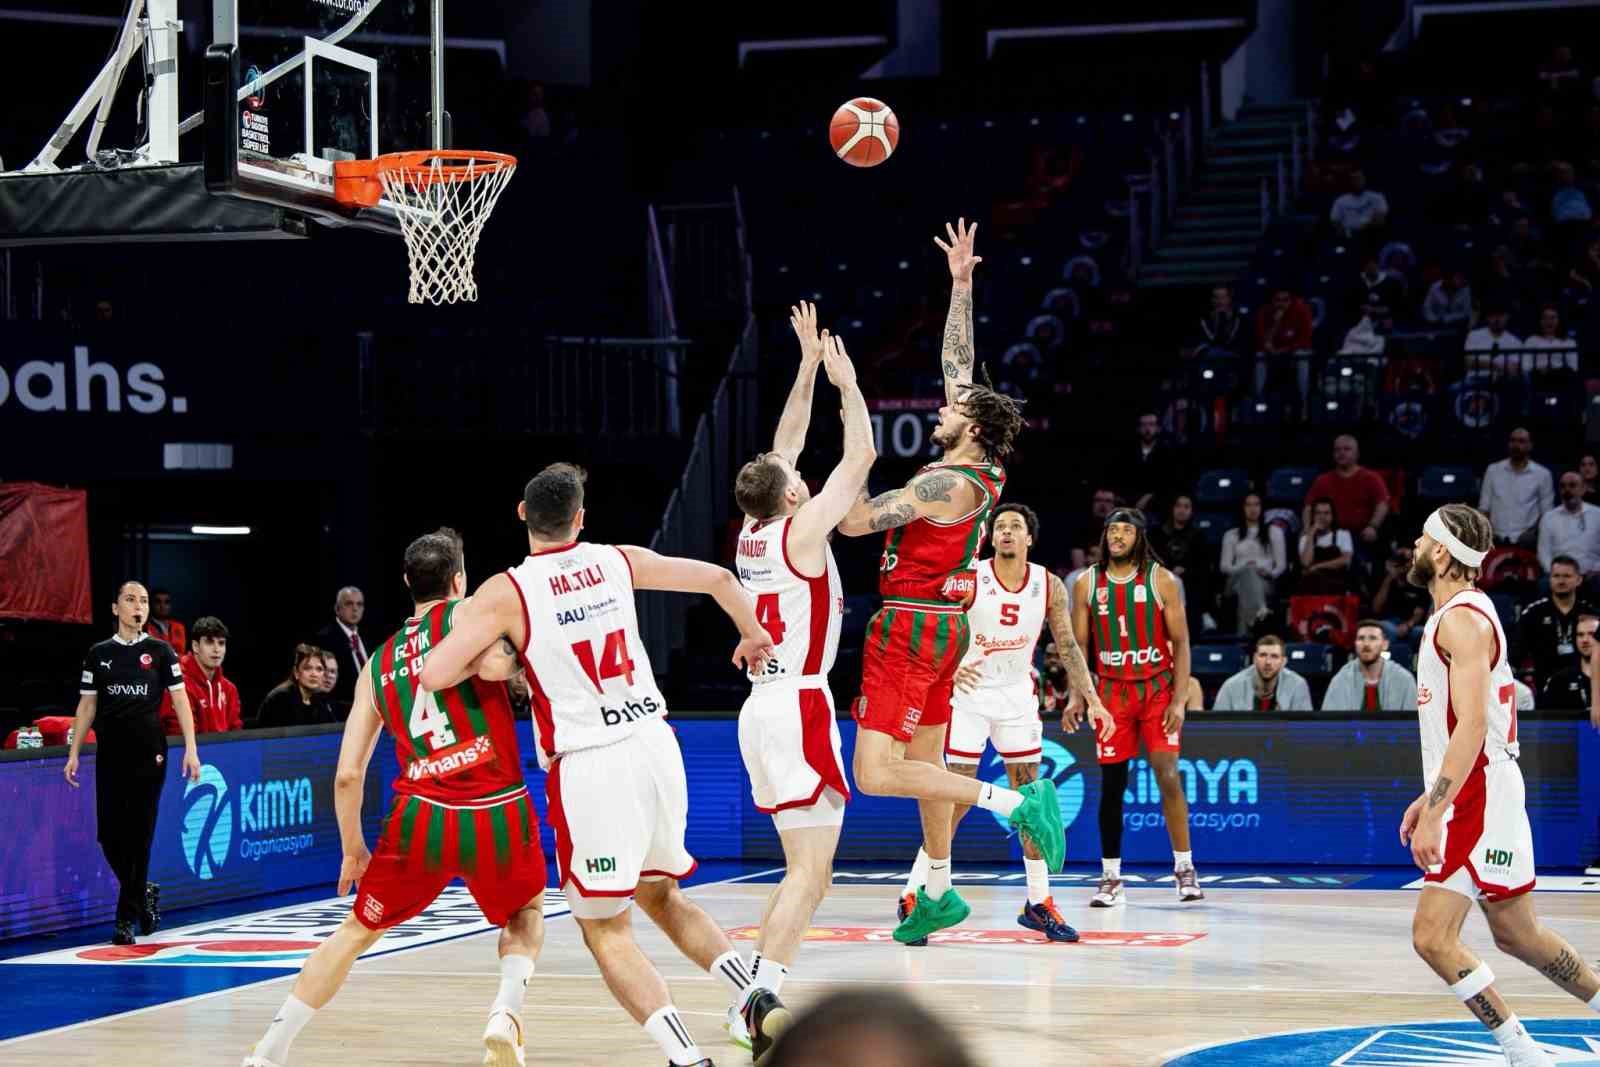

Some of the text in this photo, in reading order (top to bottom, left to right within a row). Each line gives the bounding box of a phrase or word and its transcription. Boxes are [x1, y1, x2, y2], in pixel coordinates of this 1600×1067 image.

[1000, 603, 1021, 626] 5
[1117, 615, 1129, 637] 1
[571, 628, 635, 695] 14
[409, 684, 457, 751] 4
[240, 833, 314, 862] Organizasyon
[1485, 848, 1513, 868] HDI
[585, 856, 617, 873] HDI
